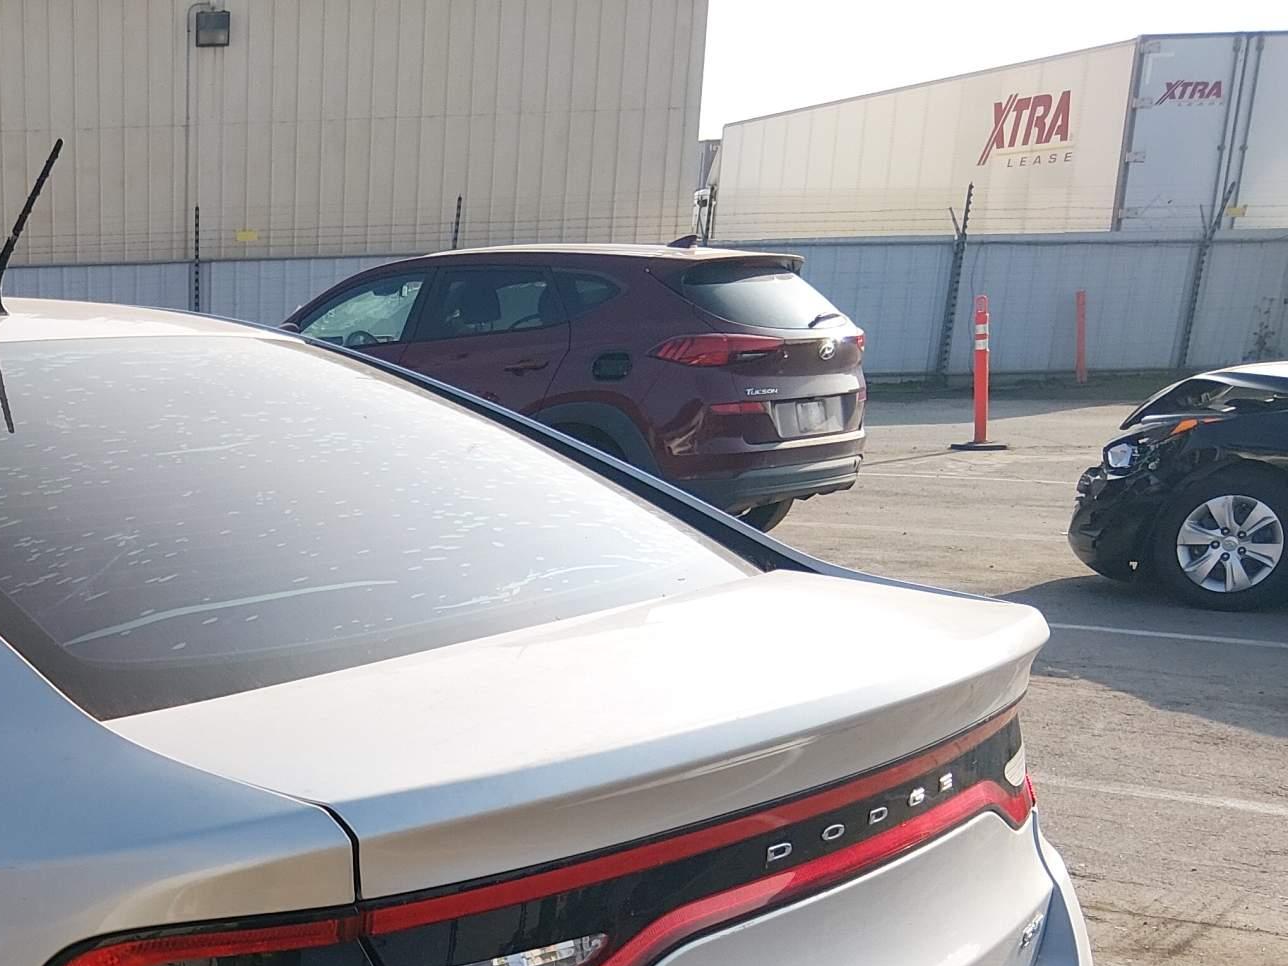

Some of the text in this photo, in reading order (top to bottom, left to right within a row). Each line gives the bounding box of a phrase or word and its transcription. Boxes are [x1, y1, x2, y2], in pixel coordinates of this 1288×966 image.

[1154, 80, 1222, 105] XTRA
[977, 90, 1071, 166] XTRA
[1007, 152, 1073, 168] LEASE
[745, 388, 779, 396] TUCSON
[766, 772, 953, 863] DODGE
